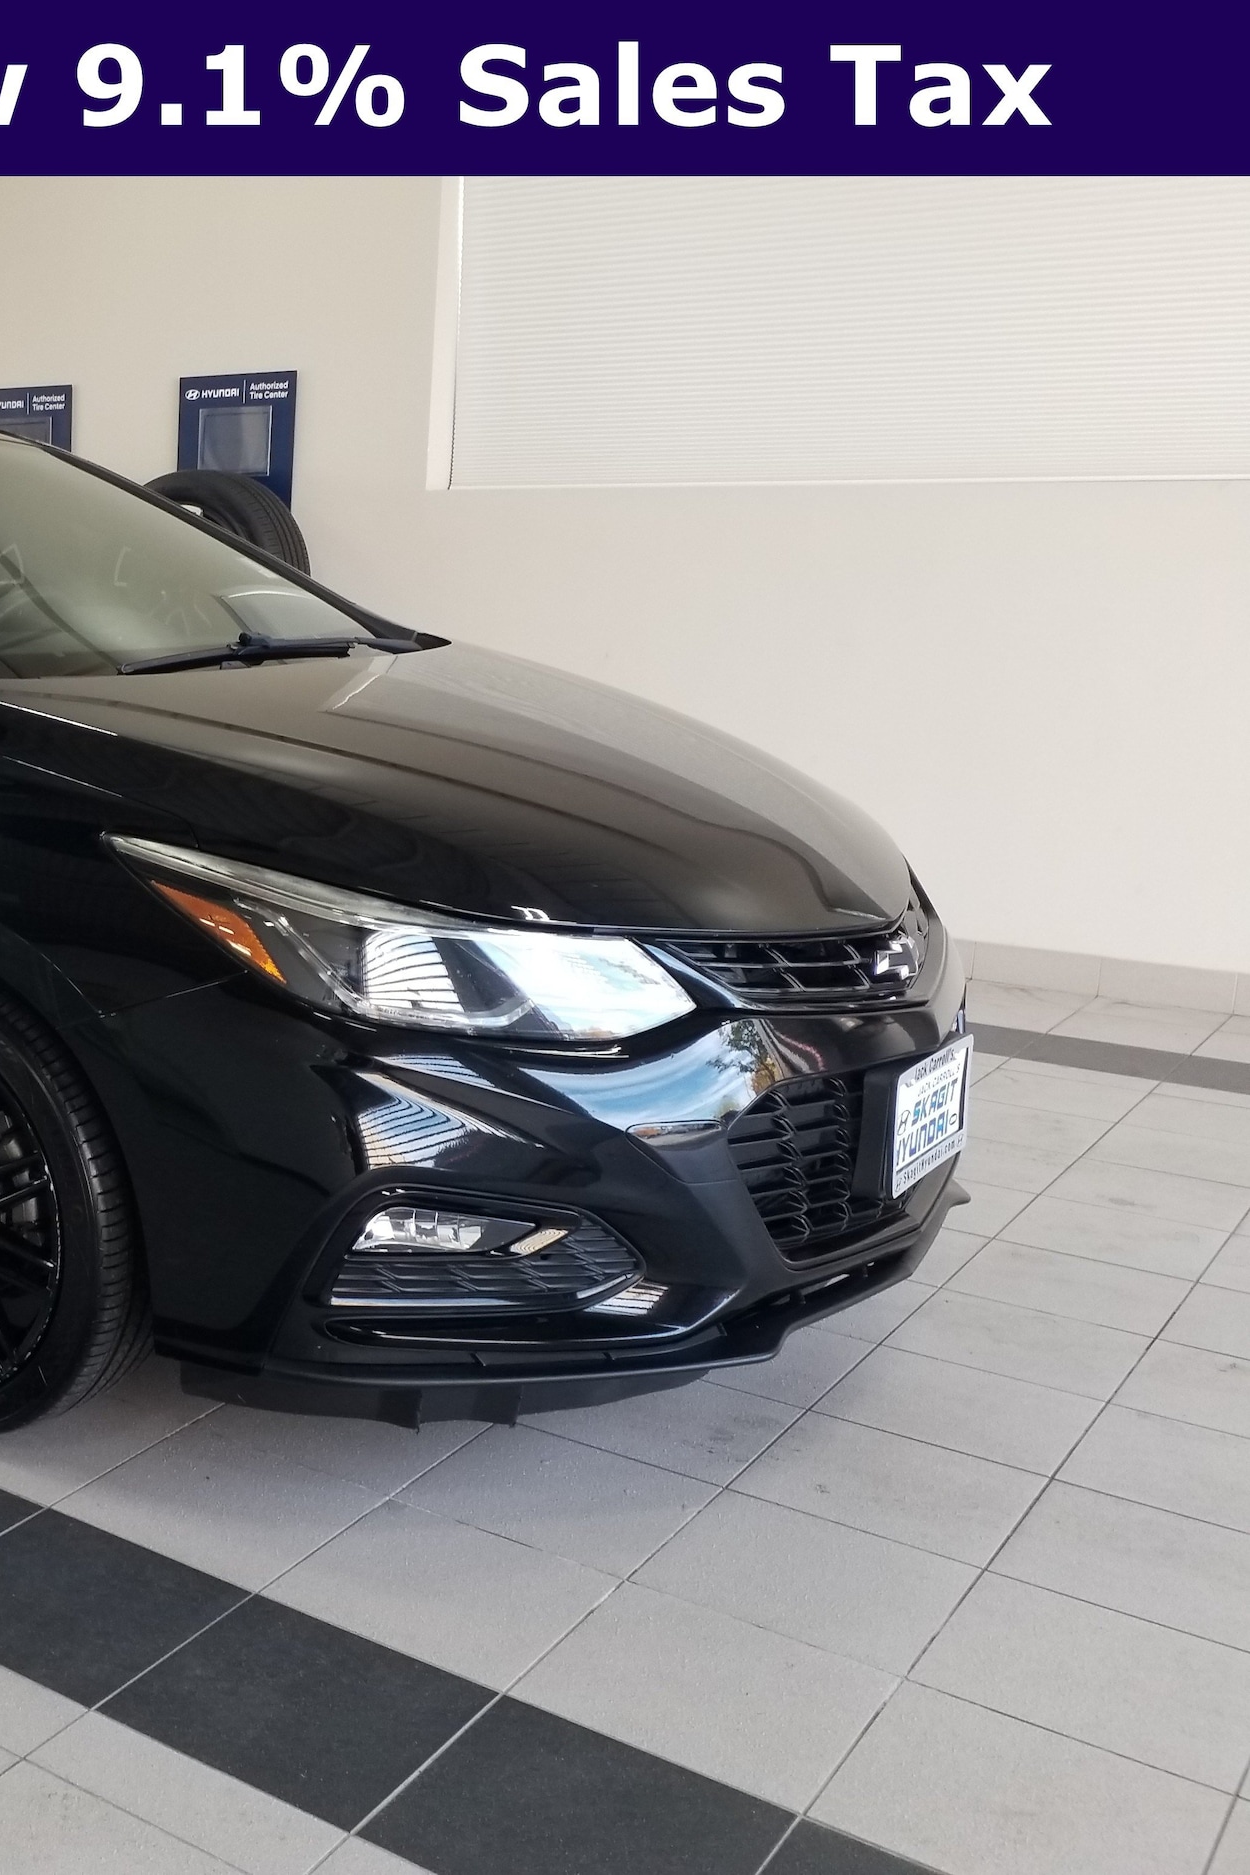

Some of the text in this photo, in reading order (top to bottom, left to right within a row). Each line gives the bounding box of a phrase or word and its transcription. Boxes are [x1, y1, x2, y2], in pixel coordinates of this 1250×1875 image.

[250, 381, 289, 391] Authorized
[32, 393, 65, 403] Authorized
[201, 388, 240, 398] HYUNDAI
[250, 390, 288, 399] Tire Center
[32, 402, 65, 411] Tire Center
[911, 1078, 959, 1127] SKAGIT
[903, 1143, 956, 1185] SkagitHyundai.com
